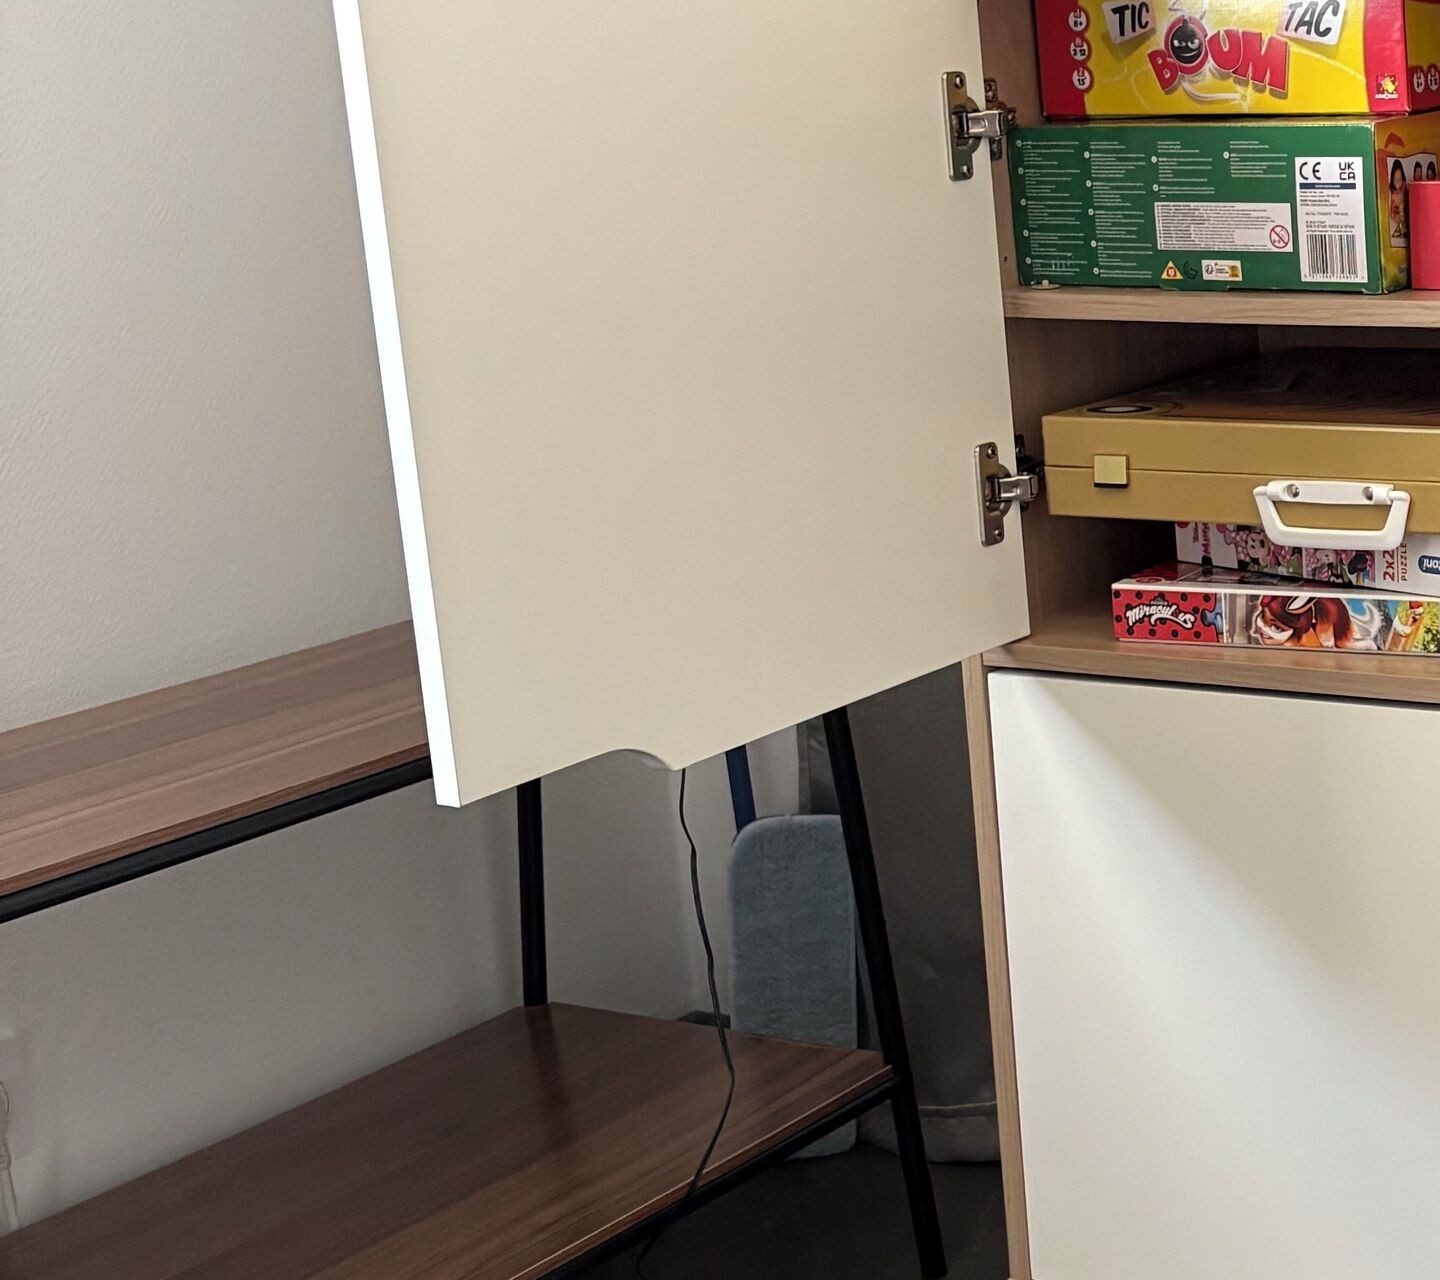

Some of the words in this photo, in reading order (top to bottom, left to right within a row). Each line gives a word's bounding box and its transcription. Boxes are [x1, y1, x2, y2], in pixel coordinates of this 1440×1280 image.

[1110, 1, 1150, 37] TIC
[1284, 0, 1341, 38] TAC
[1147, 14, 1289, 93] BOUM
[1338, 161, 1354, 171] UK
[1339, 172, 1356, 181] CA
[1382, 548, 1396, 582] 2x2
